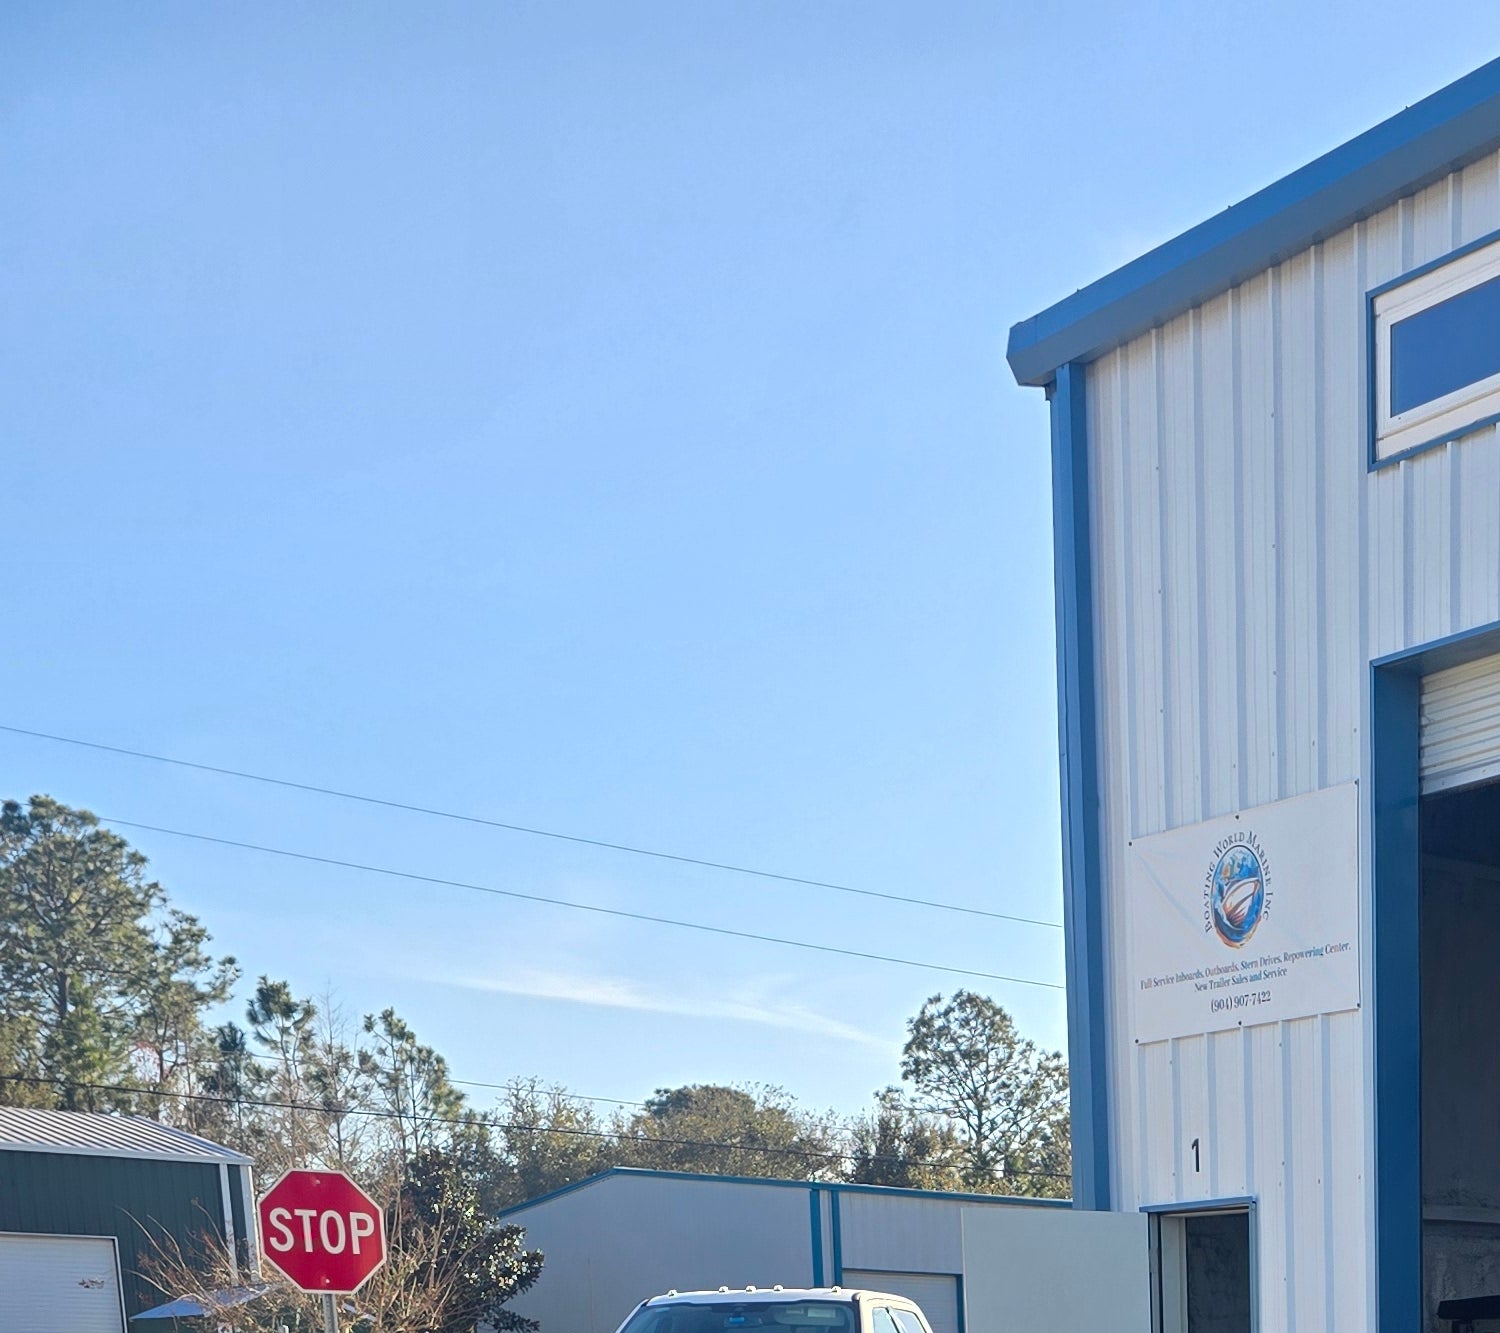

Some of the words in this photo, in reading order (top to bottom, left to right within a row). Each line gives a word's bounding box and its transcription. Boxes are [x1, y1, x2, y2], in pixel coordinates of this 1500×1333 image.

[1203, 862, 1216, 933] BOATING
[1213, 831, 1245, 859] WORLD
[1246, 830, 1272, 886] MARINE
[1263, 892, 1274, 920] INC
[1140, 977, 1153, 990] Full
[1153, 975, 1175, 988] Service
[1240, 960, 1259, 971] Stern
[1283, 946, 1324, 963] Repowering
[1194, 983, 1208, 992] New
[1209, 977, 1231, 990] Trailer
[1231, 973, 1249, 985] Sales
[1249, 970, 1262, 982] and
[1262, 966, 1287, 980] Service
[1210, 995, 1233, 1013] (904)
[1233, 990, 1271, 1009] 907-7422
[1191, 1138, 1200, 1173] 1
[269, 1207, 375, 1255] STOP
